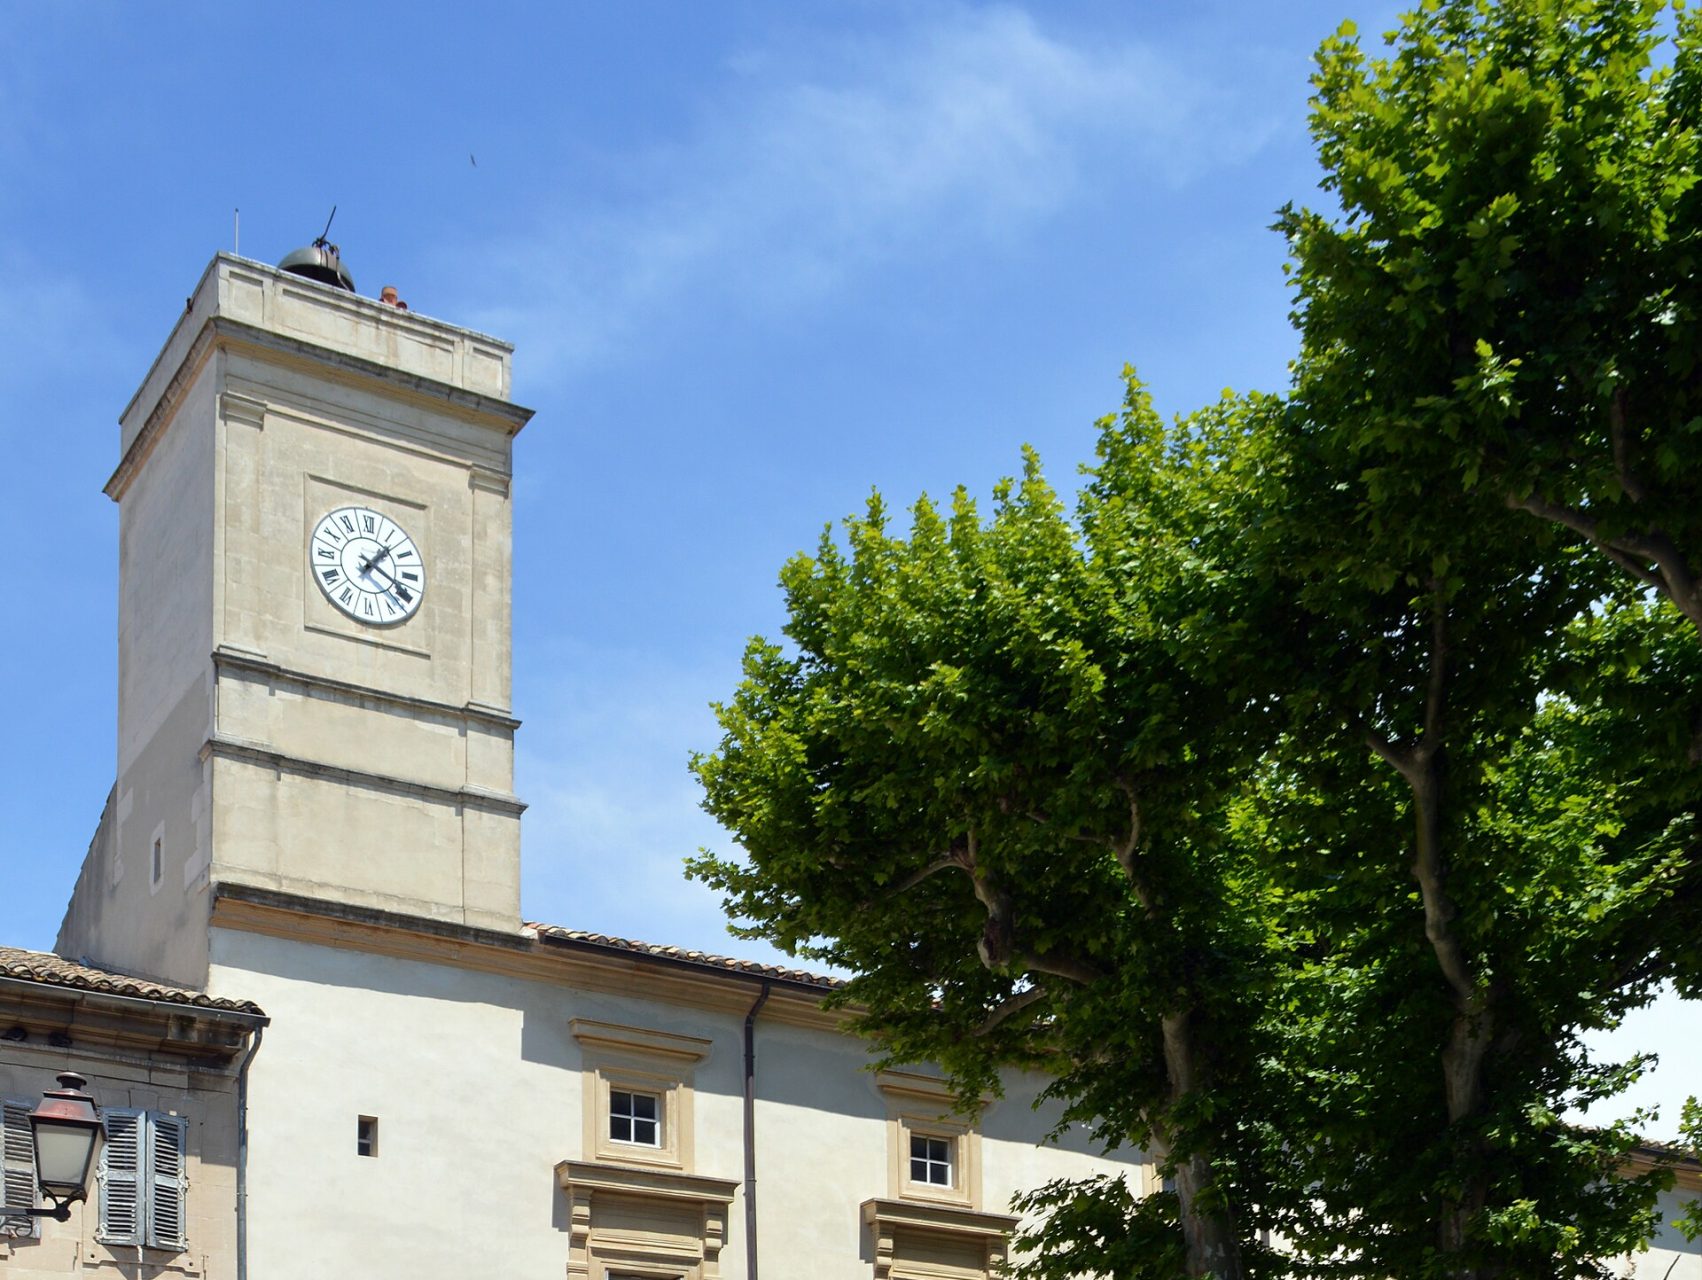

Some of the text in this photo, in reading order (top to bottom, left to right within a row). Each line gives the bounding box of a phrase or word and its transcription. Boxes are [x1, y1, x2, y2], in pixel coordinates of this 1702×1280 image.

[363, 515, 375, 533] XII
[324, 527, 341, 542] X
[385, 530, 395, 542] I
[318, 548, 335, 559] IX
[364, 597, 374, 616] VI
[385, 599, 396, 615] V
